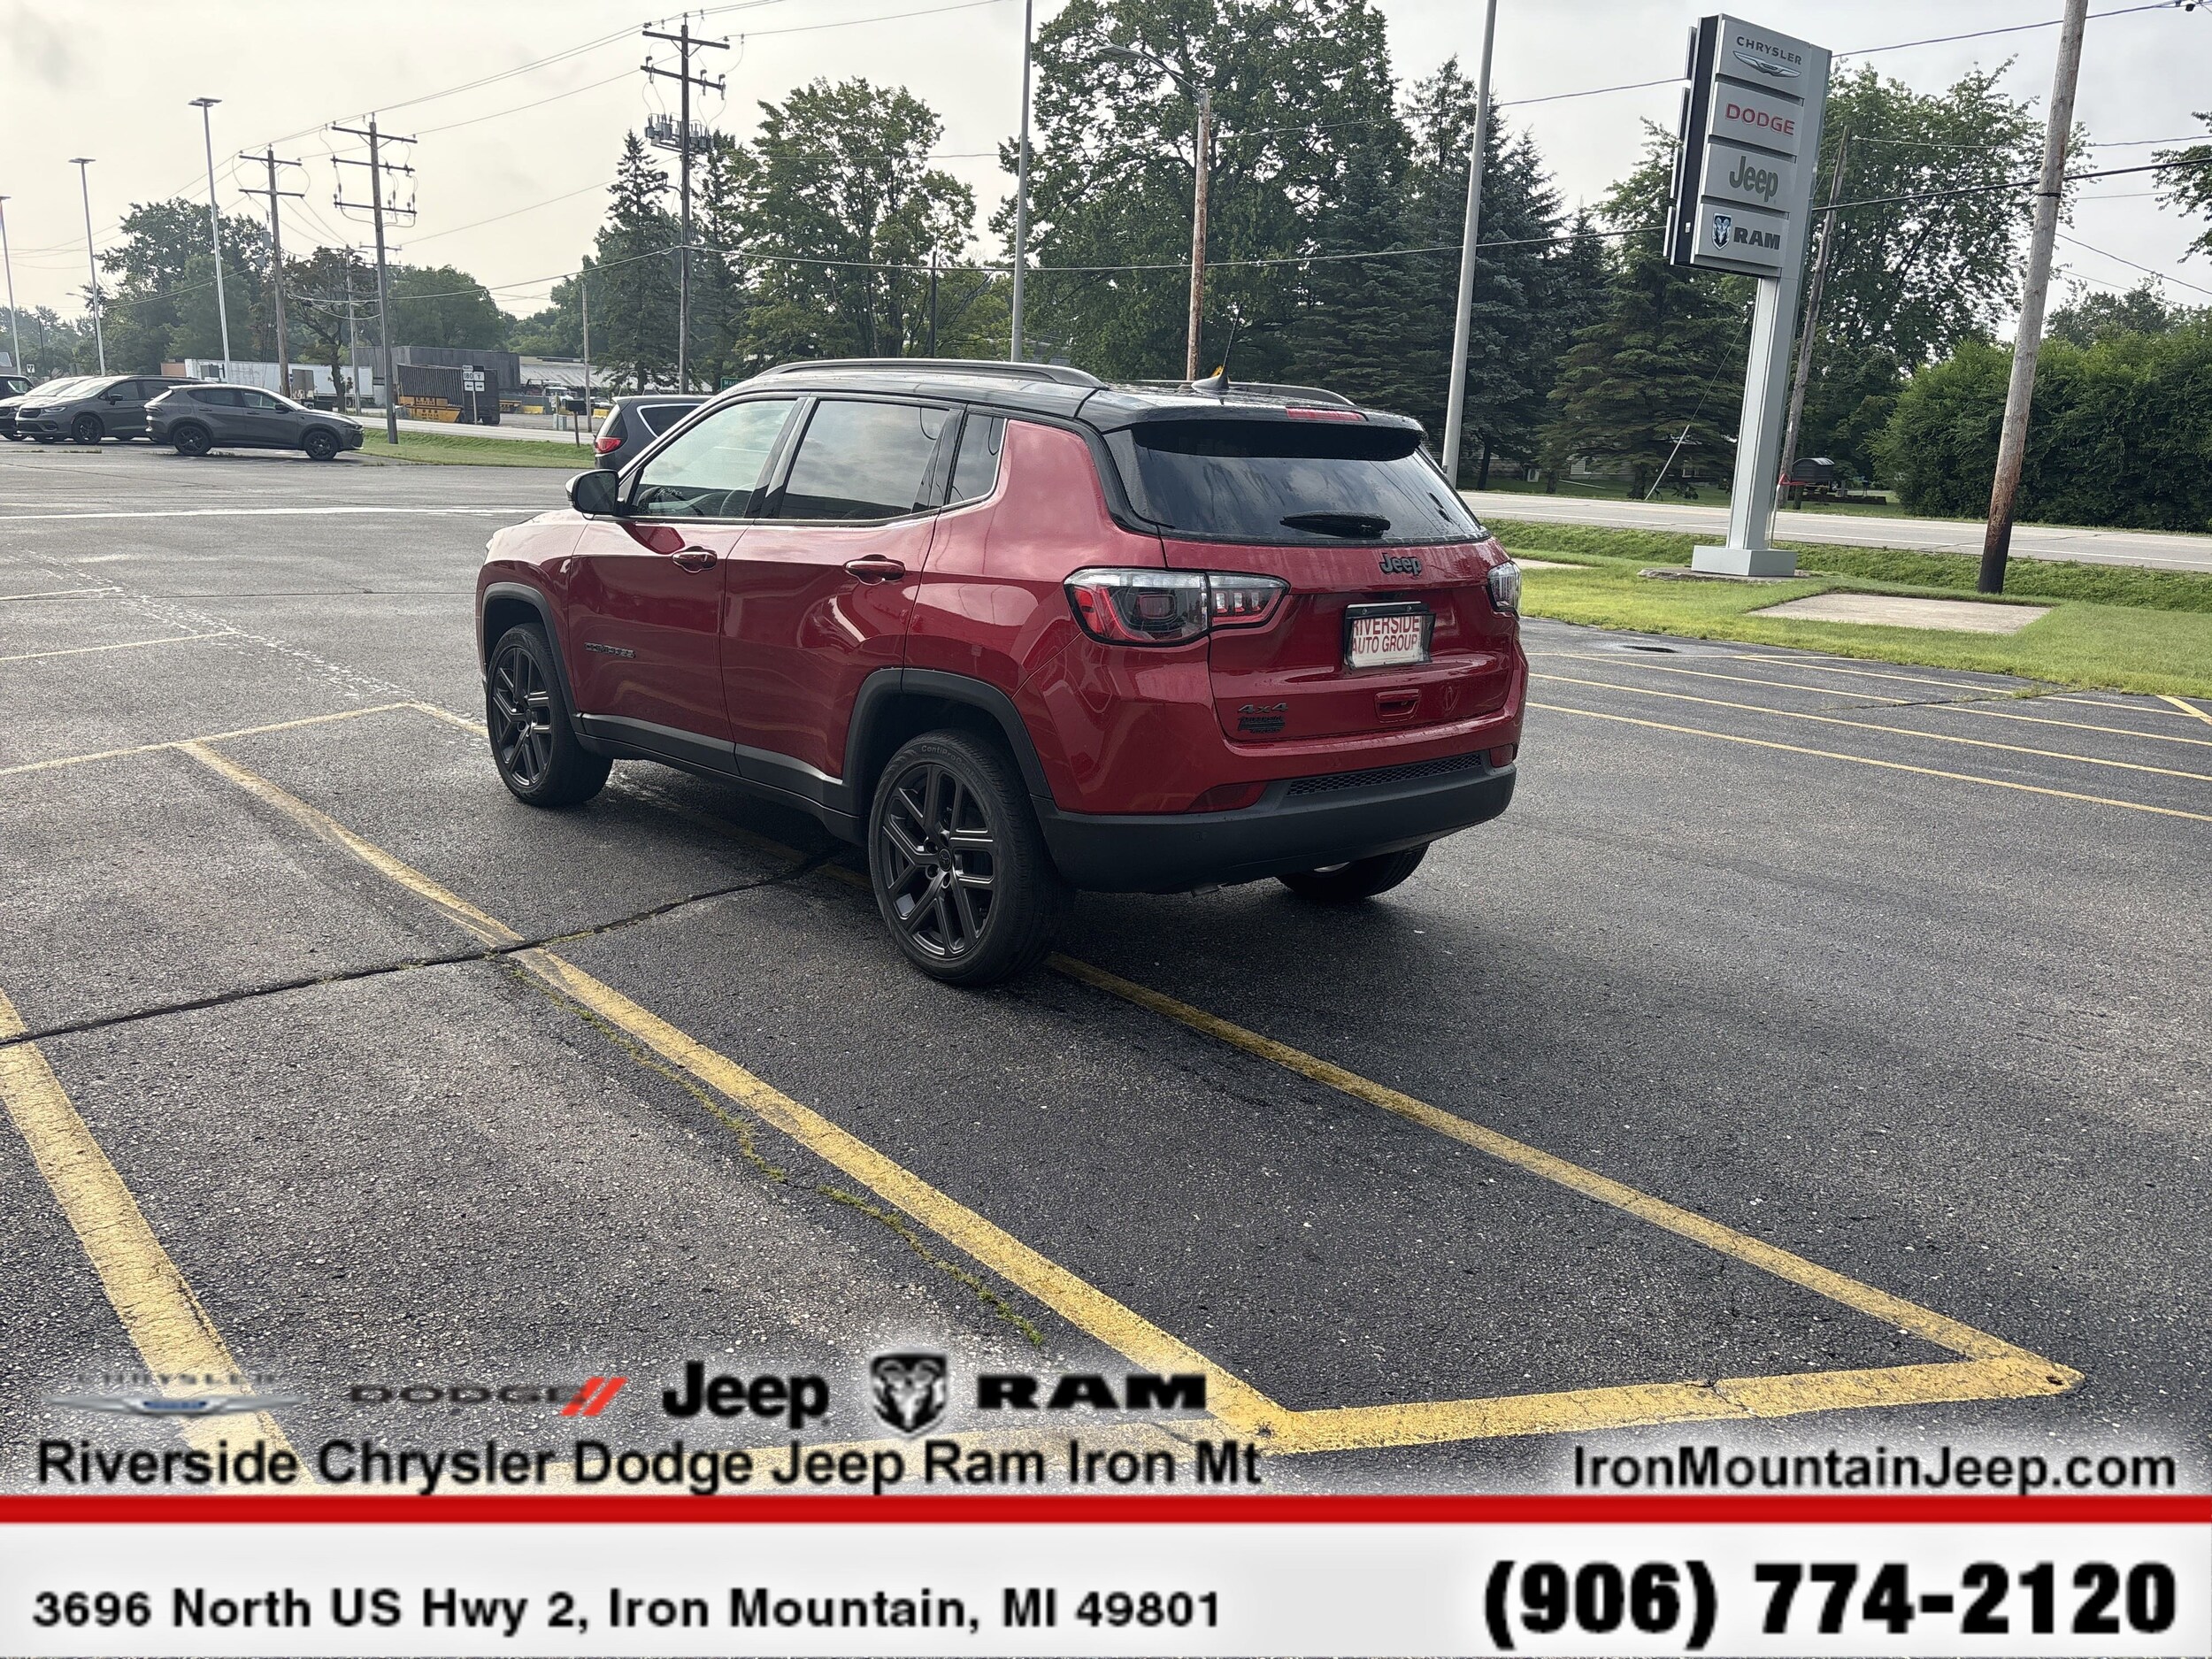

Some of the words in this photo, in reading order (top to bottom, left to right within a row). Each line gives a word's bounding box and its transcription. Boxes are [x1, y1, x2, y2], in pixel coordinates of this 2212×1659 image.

[1736, 36, 1802, 65] CHRYSLER
[1725, 104, 1795, 136] DODGE
[1729, 156, 1778, 203] Jeep
[1733, 227, 1781, 250] RAM
[1379, 553, 1421, 576] Jeep
[1353, 616, 1419, 635] RIVERSIDE
[1352, 635, 1379, 654] AUTO
[1382, 634, 1417, 653] GROUP
